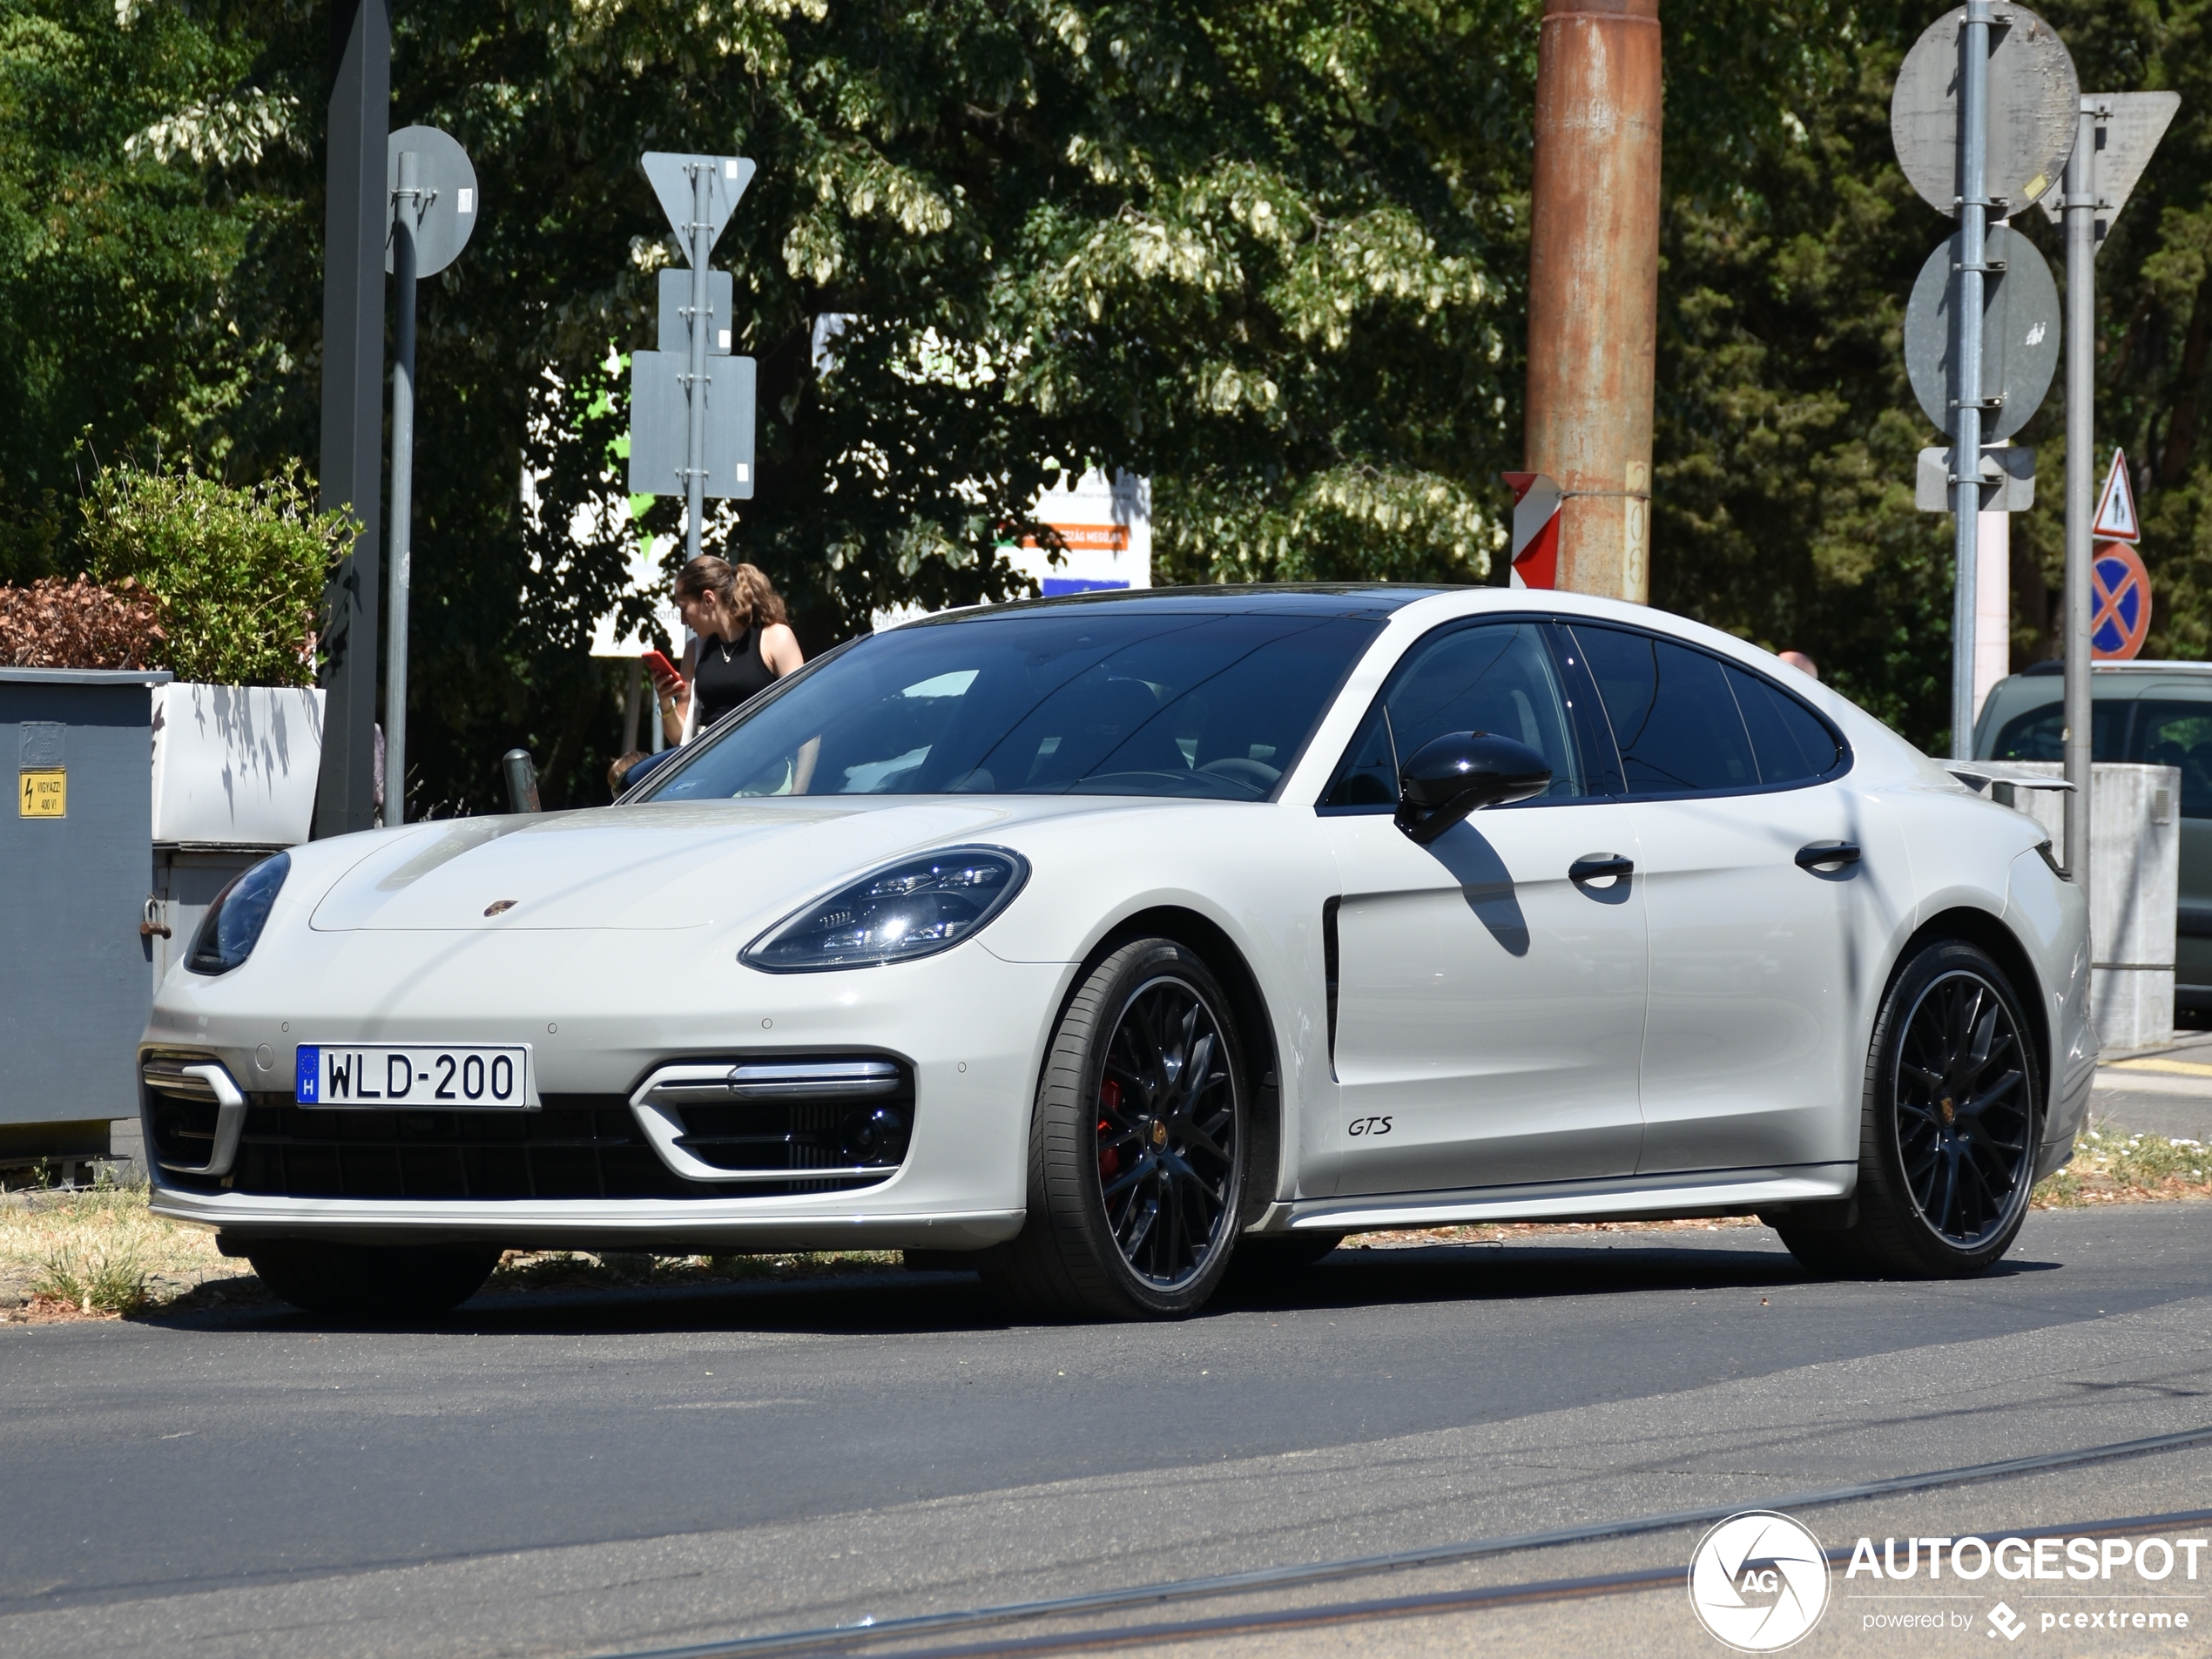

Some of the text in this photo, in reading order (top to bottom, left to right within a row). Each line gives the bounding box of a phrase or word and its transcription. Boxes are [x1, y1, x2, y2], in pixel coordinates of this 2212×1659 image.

[37, 779, 61, 793] VIGYÁZZ!
[41, 799, 51, 810] 400
[328, 1054, 513, 1099] WLD-200
[304, 1079, 314, 1095] H
[1349, 1116, 1393, 1136] GTS
